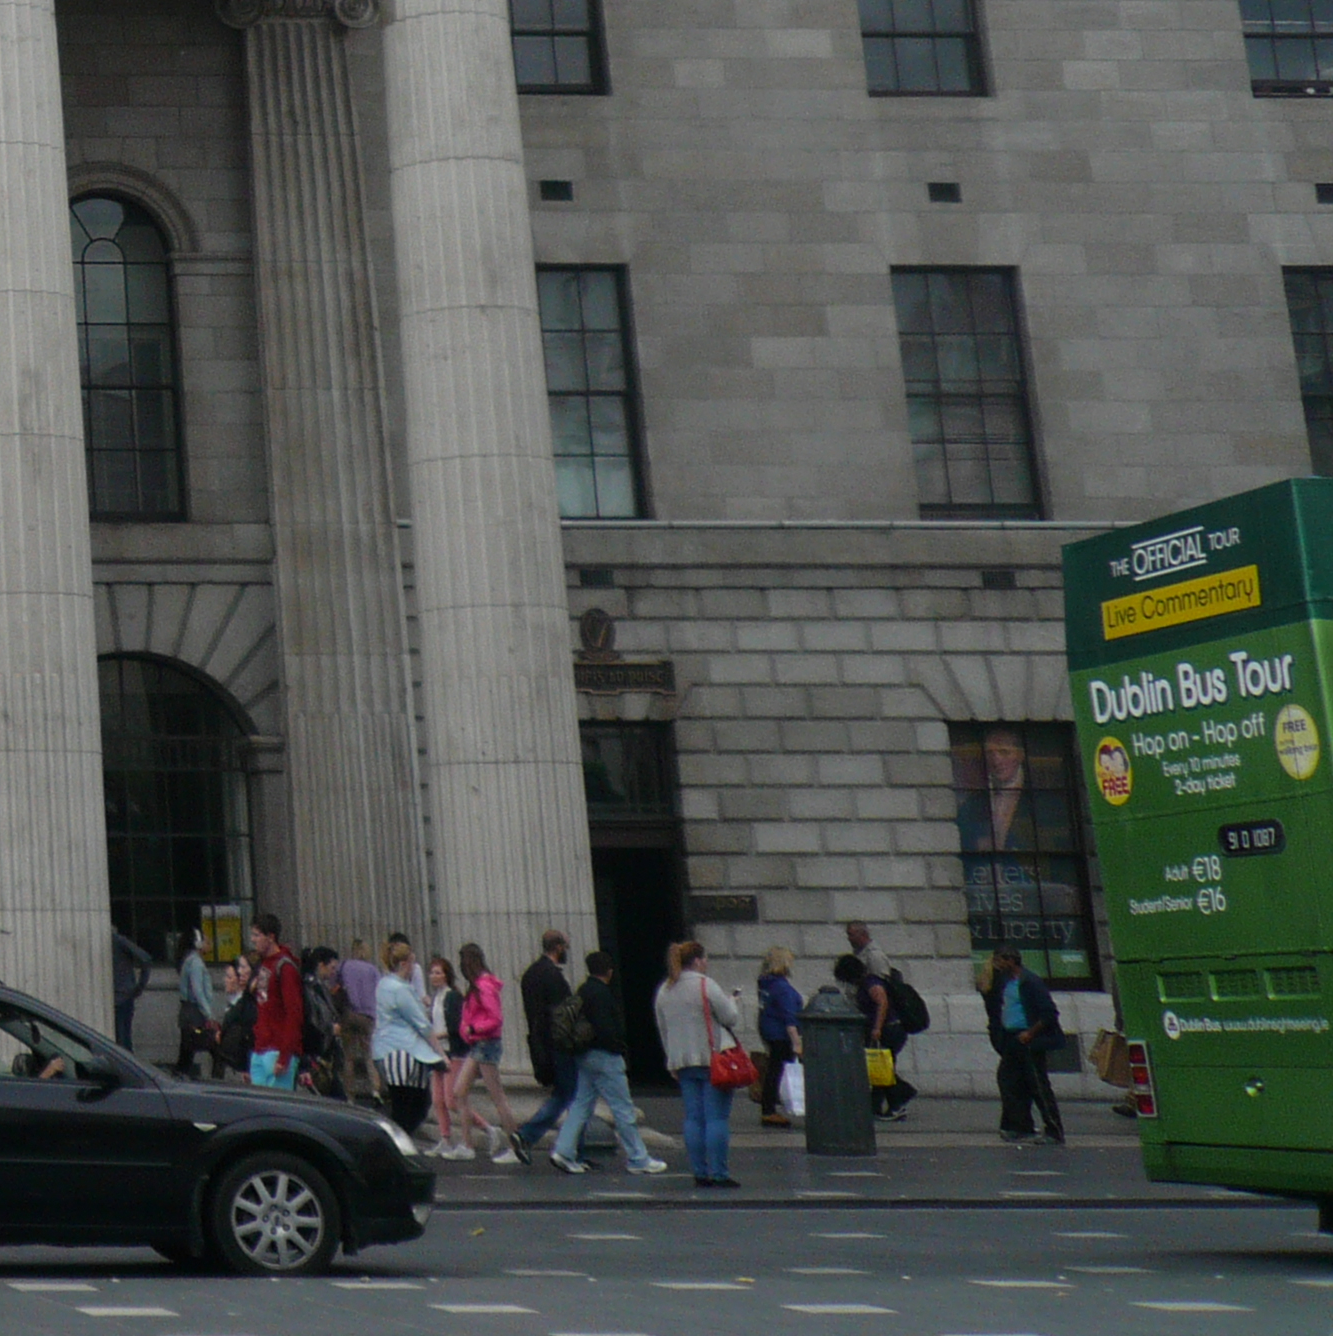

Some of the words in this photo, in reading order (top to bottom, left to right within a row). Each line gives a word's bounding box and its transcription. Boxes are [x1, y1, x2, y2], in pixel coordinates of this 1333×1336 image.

[1110, 557, 1131, 577] THE
[1132, 534, 1207, 575] OFFICIAL
[1207, 527, 1241, 551] TOUR
[1106, 604, 1136, 629] Live
[1141, 578, 1255, 620] Commentary
[1090, 671, 1175, 724] Dublin
[1177, 663, 1228, 708] Bus
[1229, 650, 1293, 697] Tour
[1131, 732, 1165, 760] Hop
[1168, 731, 1190, 751] on
[1202, 719, 1238, 748] Hop
[1241, 712, 1266, 739] off
[1281, 719, 1307, 734] FREE
[1162, 760, 1189, 778] Every
[1188, 756, 1201, 773] 10
[1201, 752, 1241, 771] minutes
[1102, 776, 1130, 797] FREE
[1174, 777, 1206, 796] 2-day
[1206, 771, 1237, 790] ticket
[964, 863, 1041, 885] etters
[1165, 863, 1189, 882] Adult
[1191, 854, 1222, 883] €18
[967, 891, 1023, 912] ives
[1129, 895, 1193, 916] Student/Senior
[1197, 886, 1227, 915] €16
[1179, 1017, 1204, 1032] Dublin
[1204, 1017, 1222, 1032] Bus
